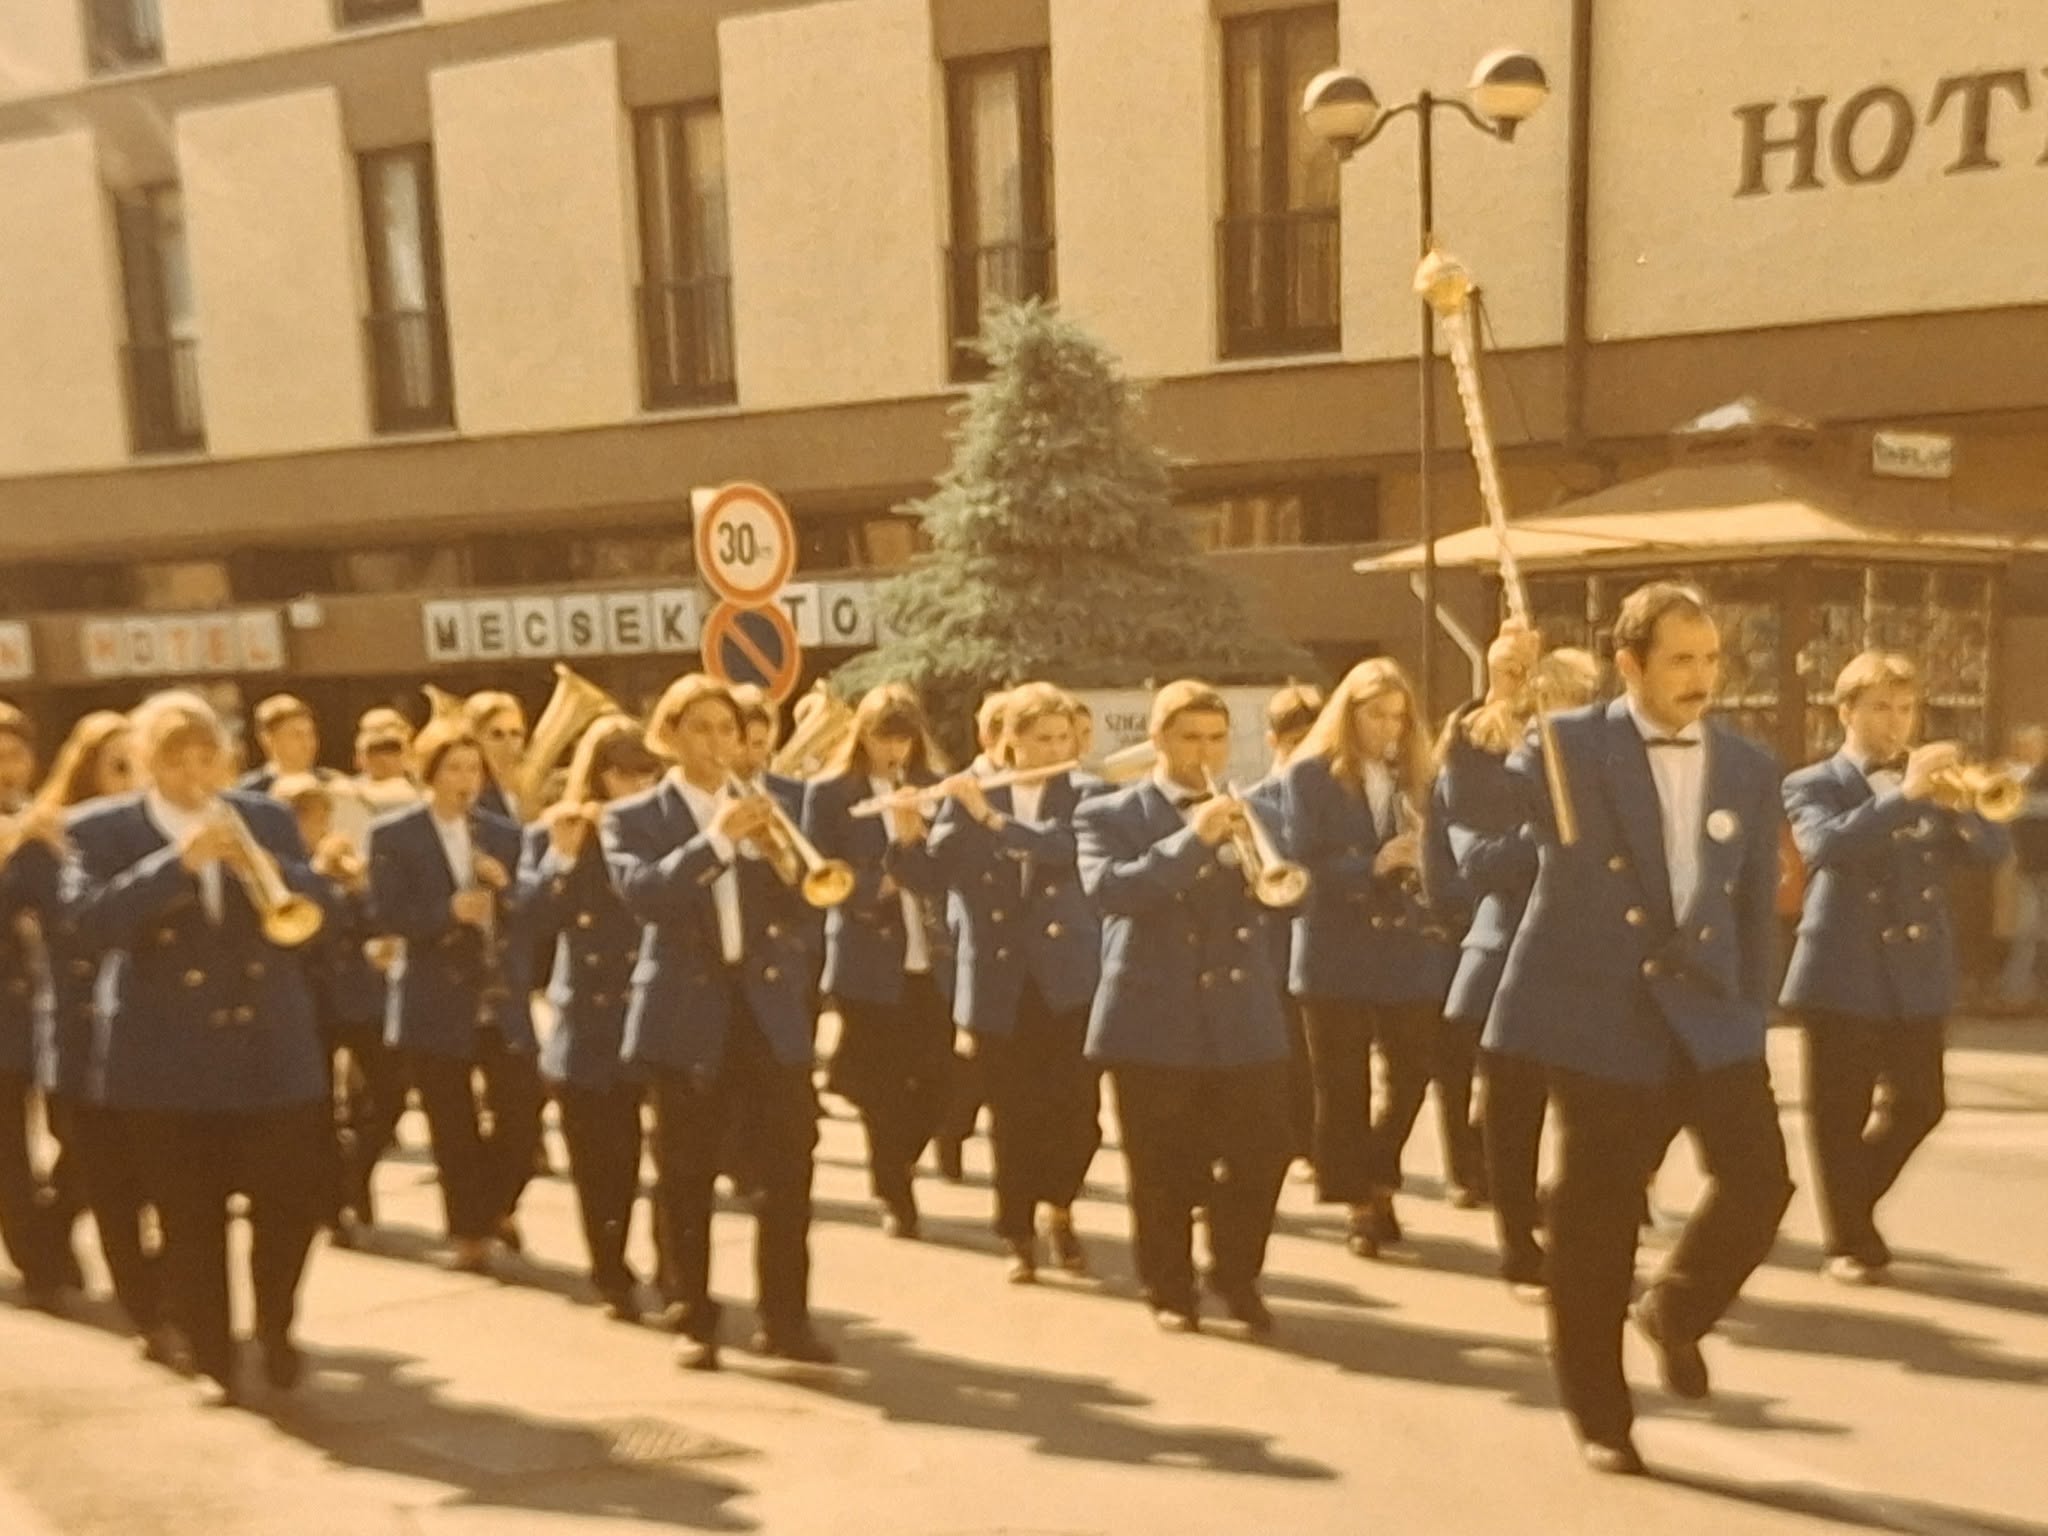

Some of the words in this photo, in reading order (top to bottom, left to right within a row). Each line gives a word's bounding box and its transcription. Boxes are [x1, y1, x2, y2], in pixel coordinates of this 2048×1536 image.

[1731, 67, 2048, 199] HOT
[718, 521, 756, 566] 30
[434, 603, 686, 651] MECSEK
